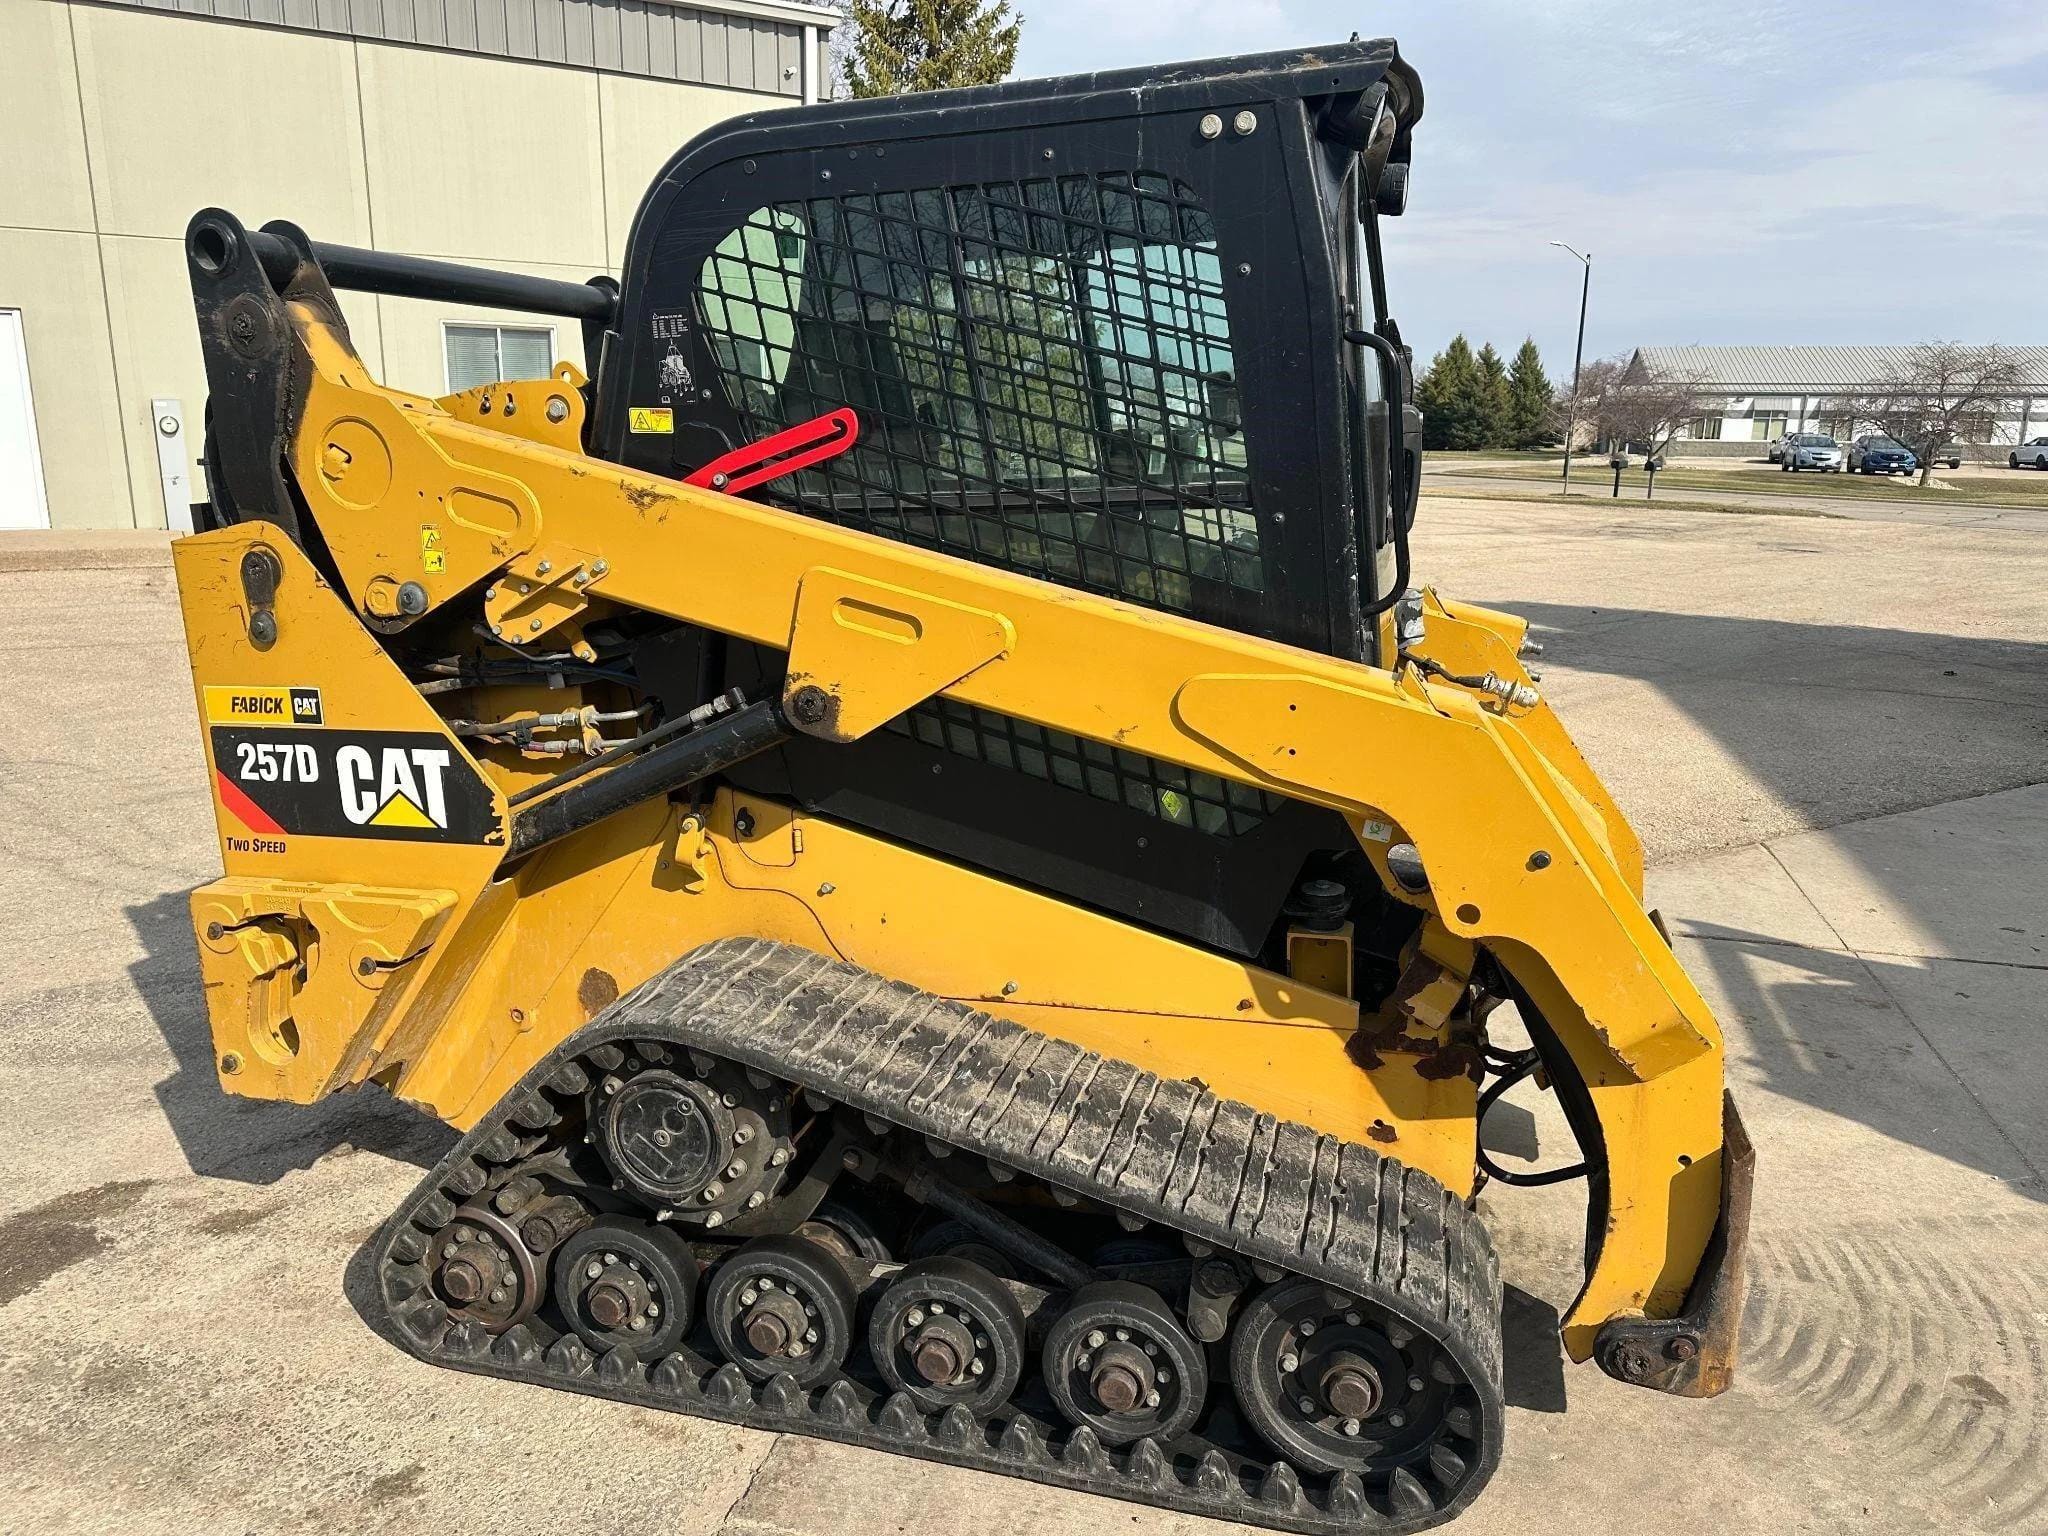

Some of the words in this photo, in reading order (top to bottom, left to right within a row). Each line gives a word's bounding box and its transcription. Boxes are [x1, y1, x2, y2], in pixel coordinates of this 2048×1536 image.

[231, 696, 283, 714] FABICK
[293, 697, 317, 716] CAT
[236, 742, 319, 783] 257D
[335, 745, 450, 829] CAT
